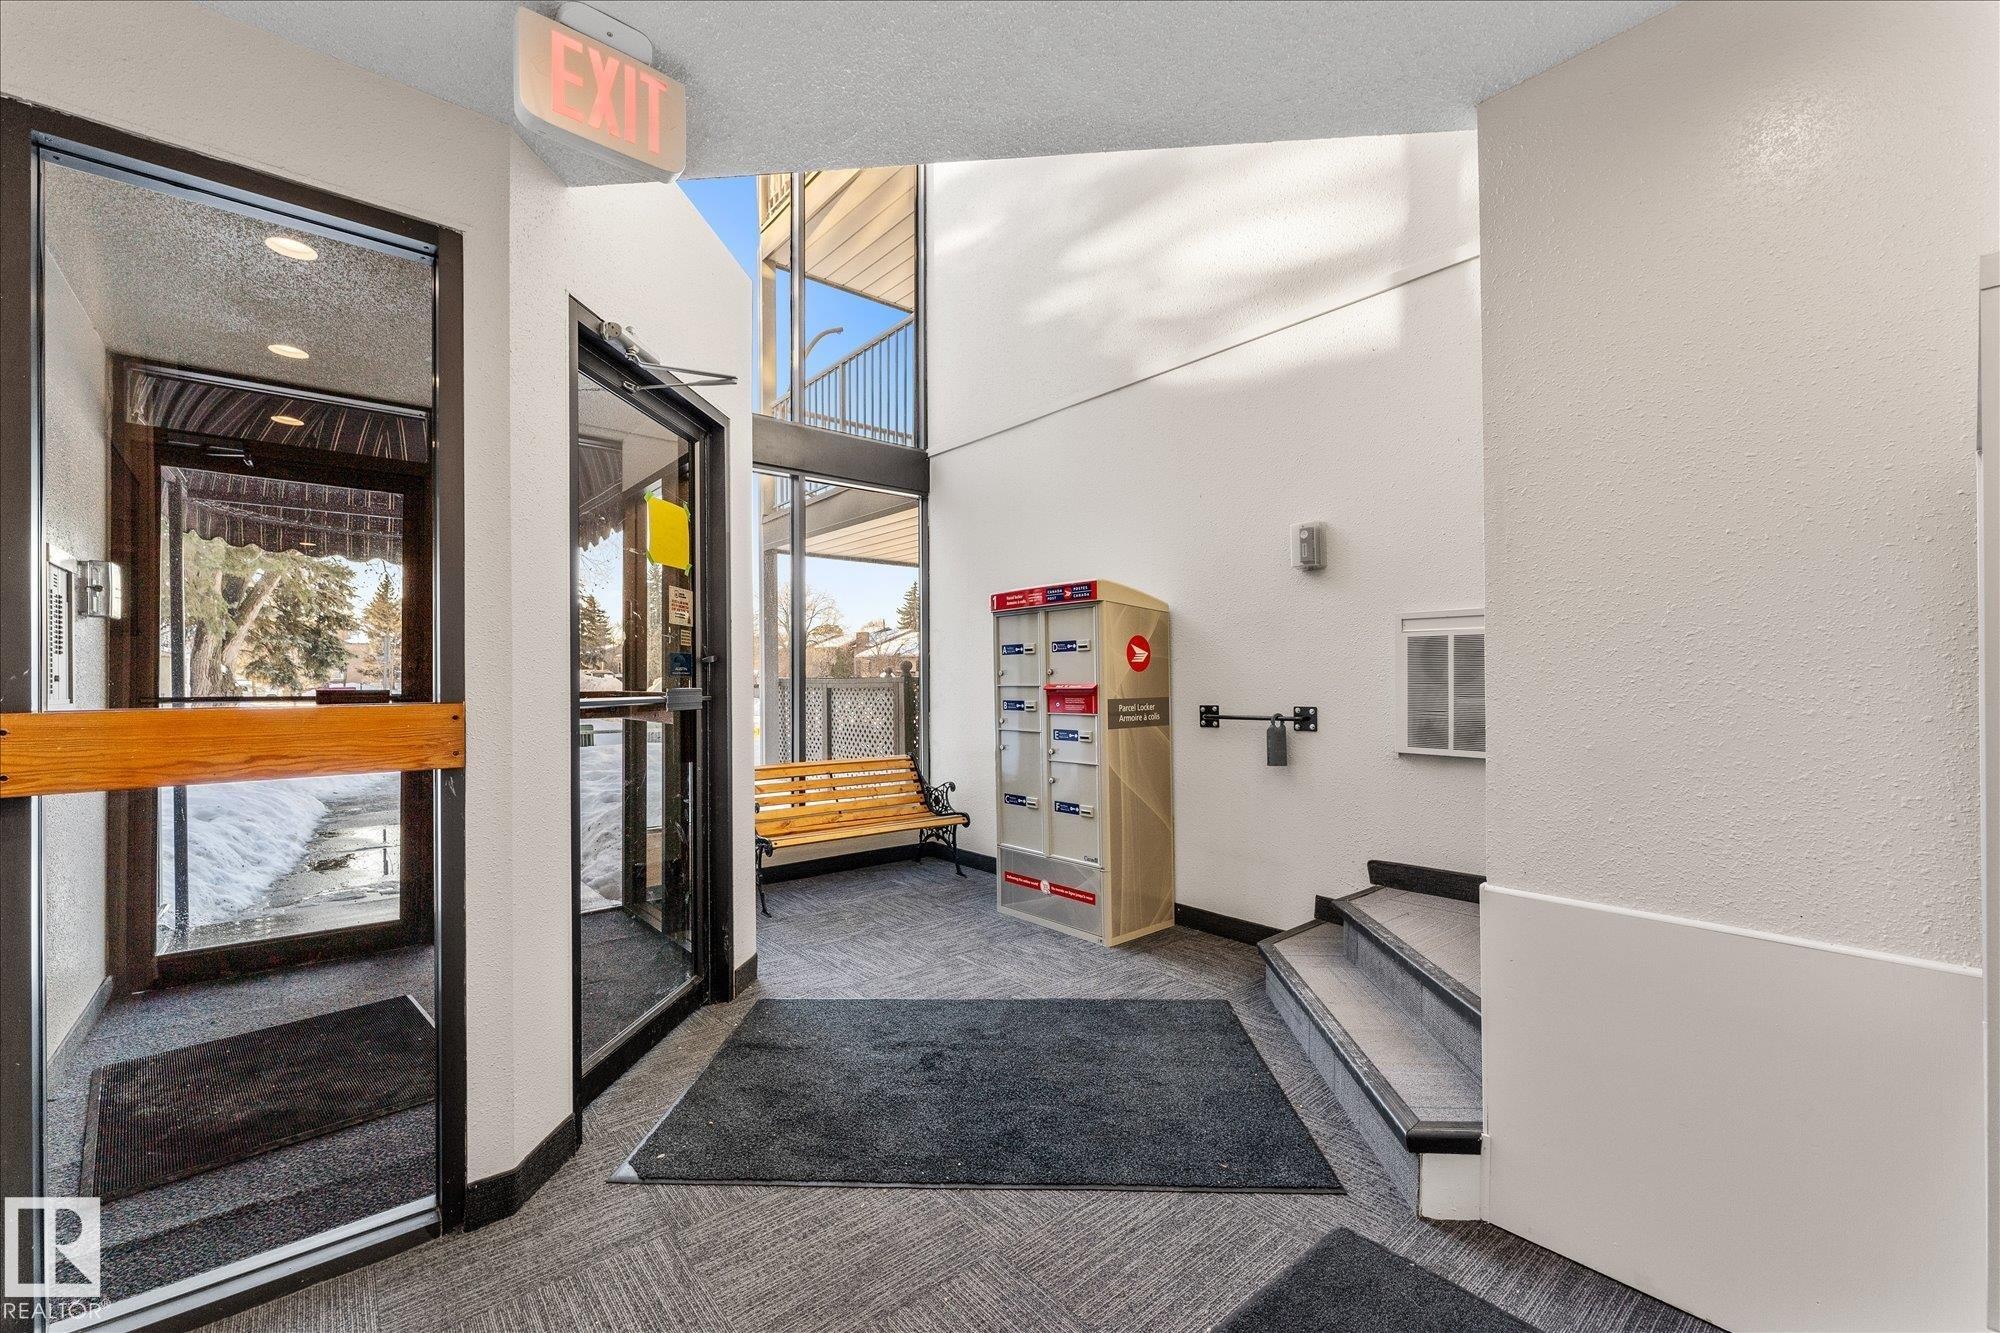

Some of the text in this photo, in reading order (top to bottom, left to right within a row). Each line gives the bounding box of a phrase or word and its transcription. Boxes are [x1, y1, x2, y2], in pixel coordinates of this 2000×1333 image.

[551, 30, 668, 155] EXIT
[1002, 646, 1007, 654] A
[1052, 643, 1058, 652] D
[1003, 701, 1008, 709] B
[1118, 703, 1155, 712] Parcel Locker
[1119, 712, 1160, 722] Armoire à colis
[1055, 731, 1059, 740] E
[1005, 795, 1010, 803] C
[1056, 803, 1060, 811] F
